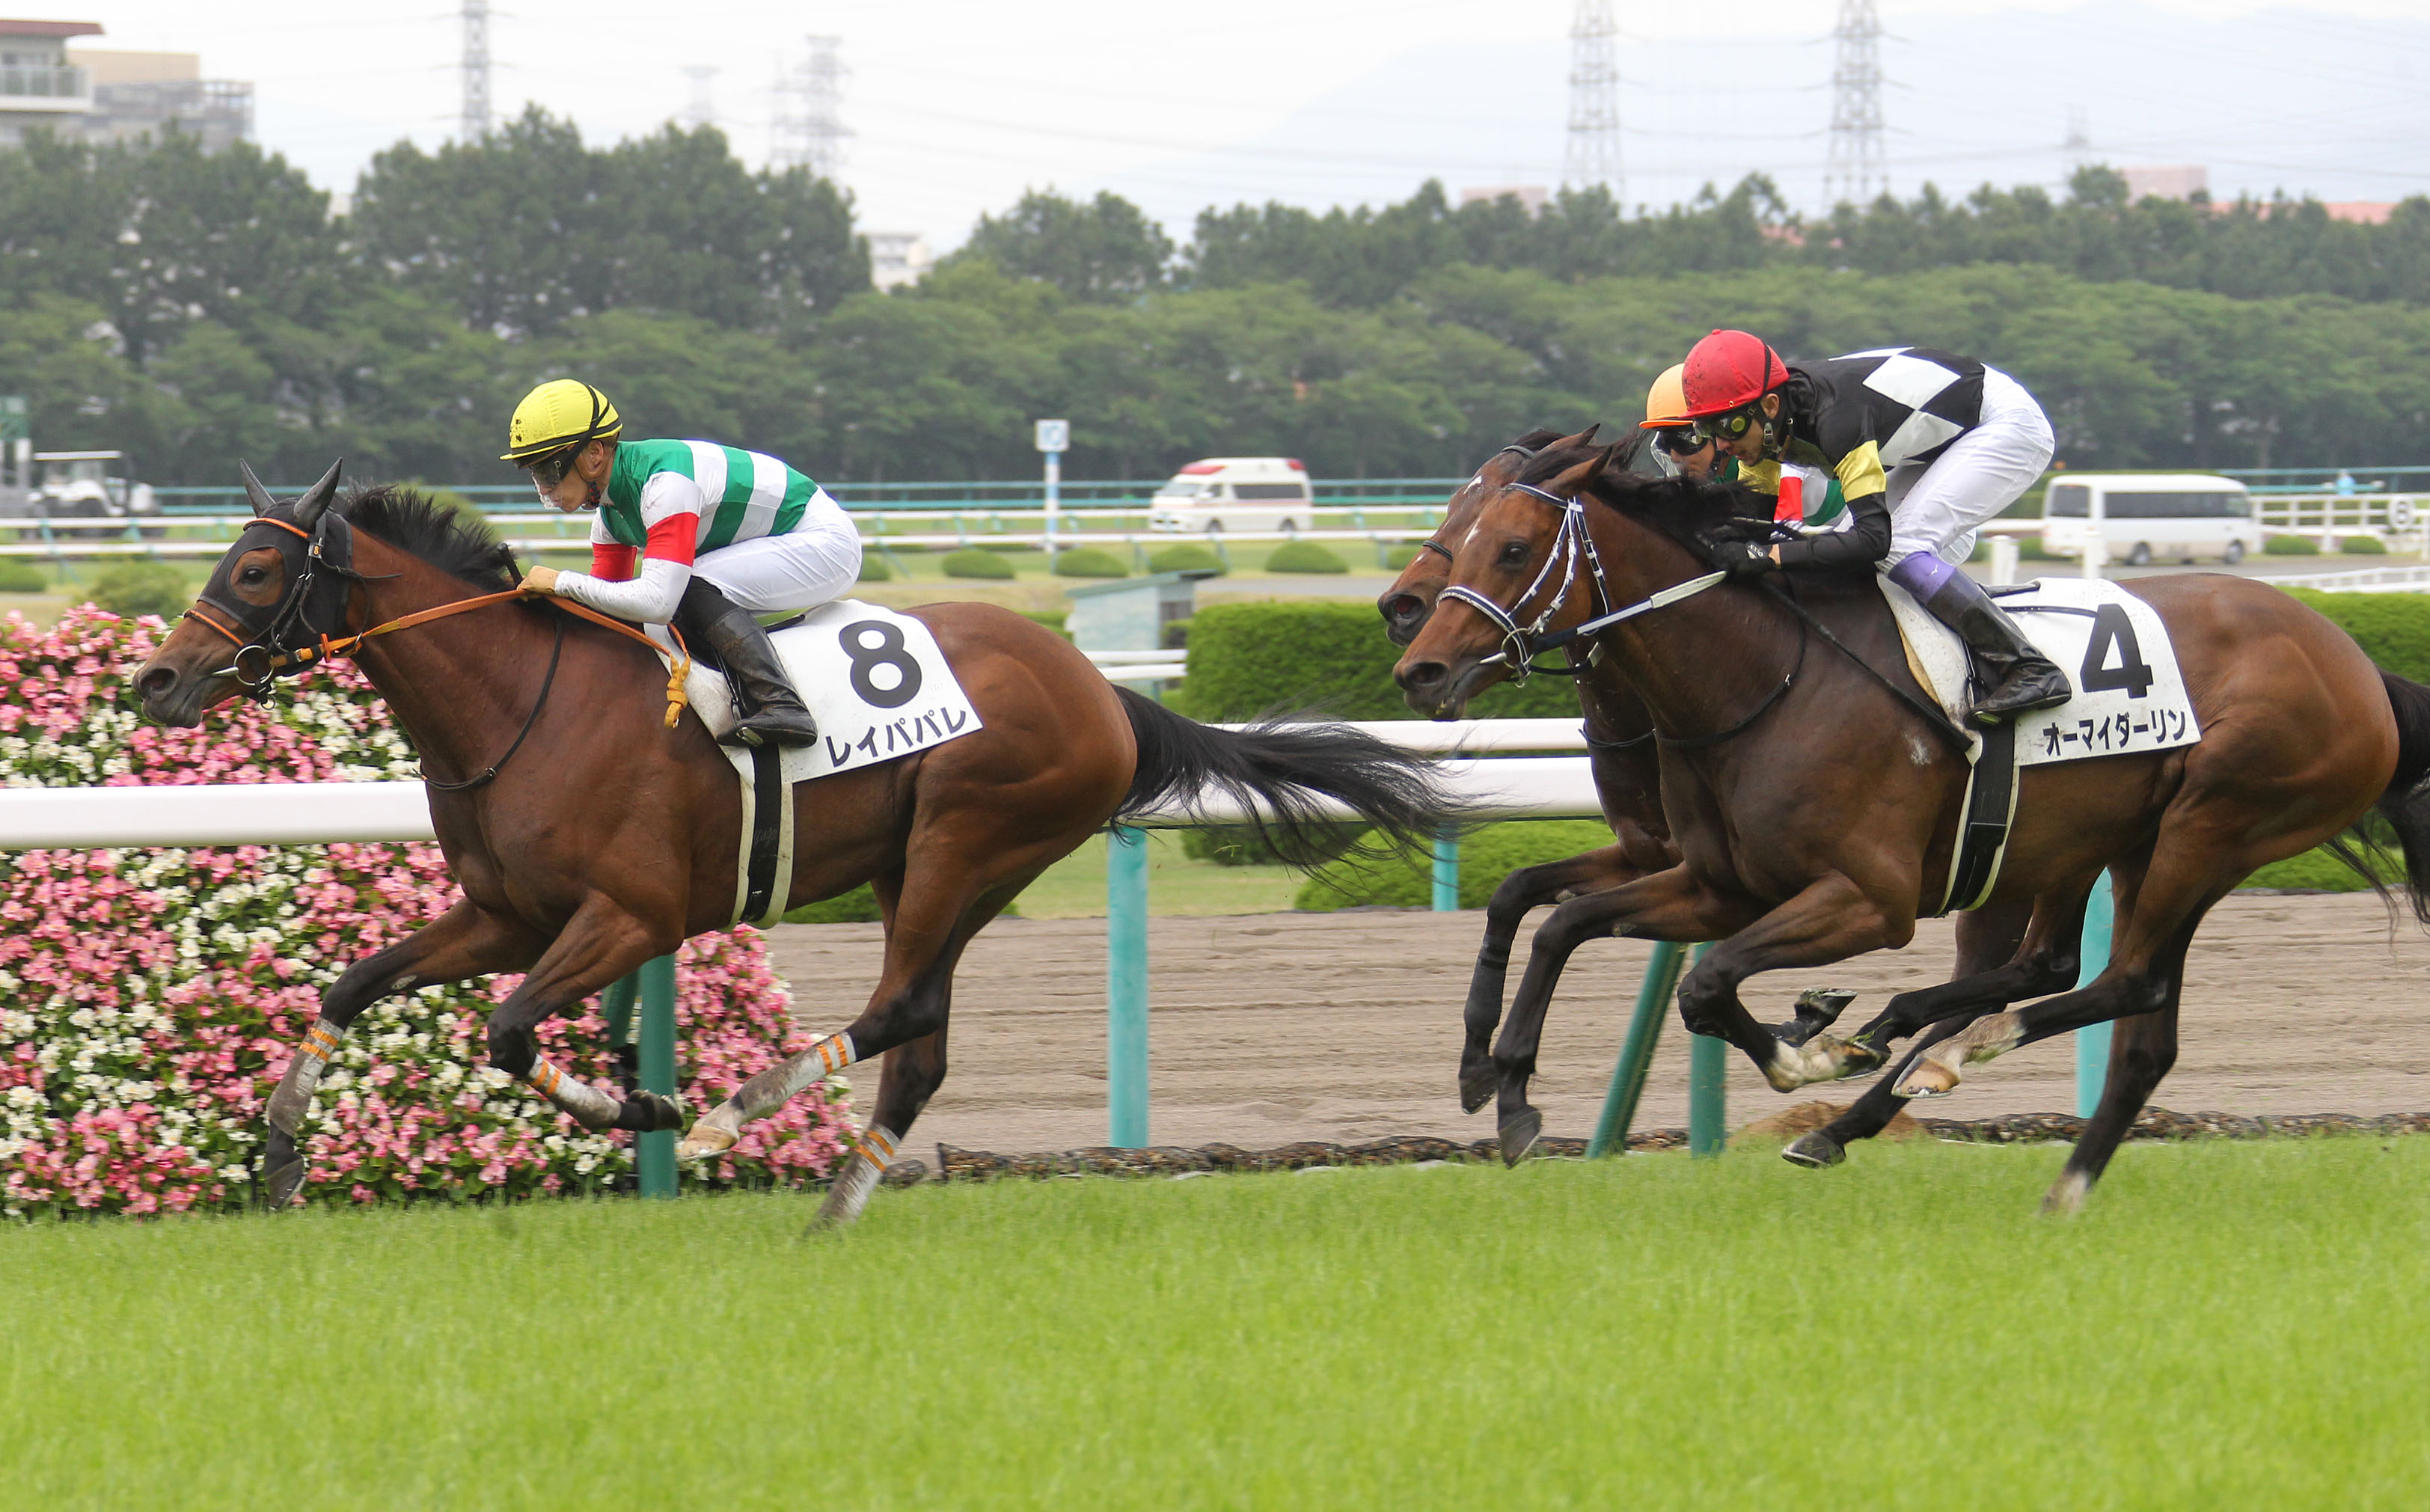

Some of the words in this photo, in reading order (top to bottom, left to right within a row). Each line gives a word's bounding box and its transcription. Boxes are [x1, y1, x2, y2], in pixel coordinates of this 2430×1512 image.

[313, 545, 319, 555] 8
[839, 619, 922, 708] 8
[2080, 603, 2154, 699] 4
[825, 706, 966, 768] レイパパレ
[2042, 708, 2186, 757] オーマイダーリン
